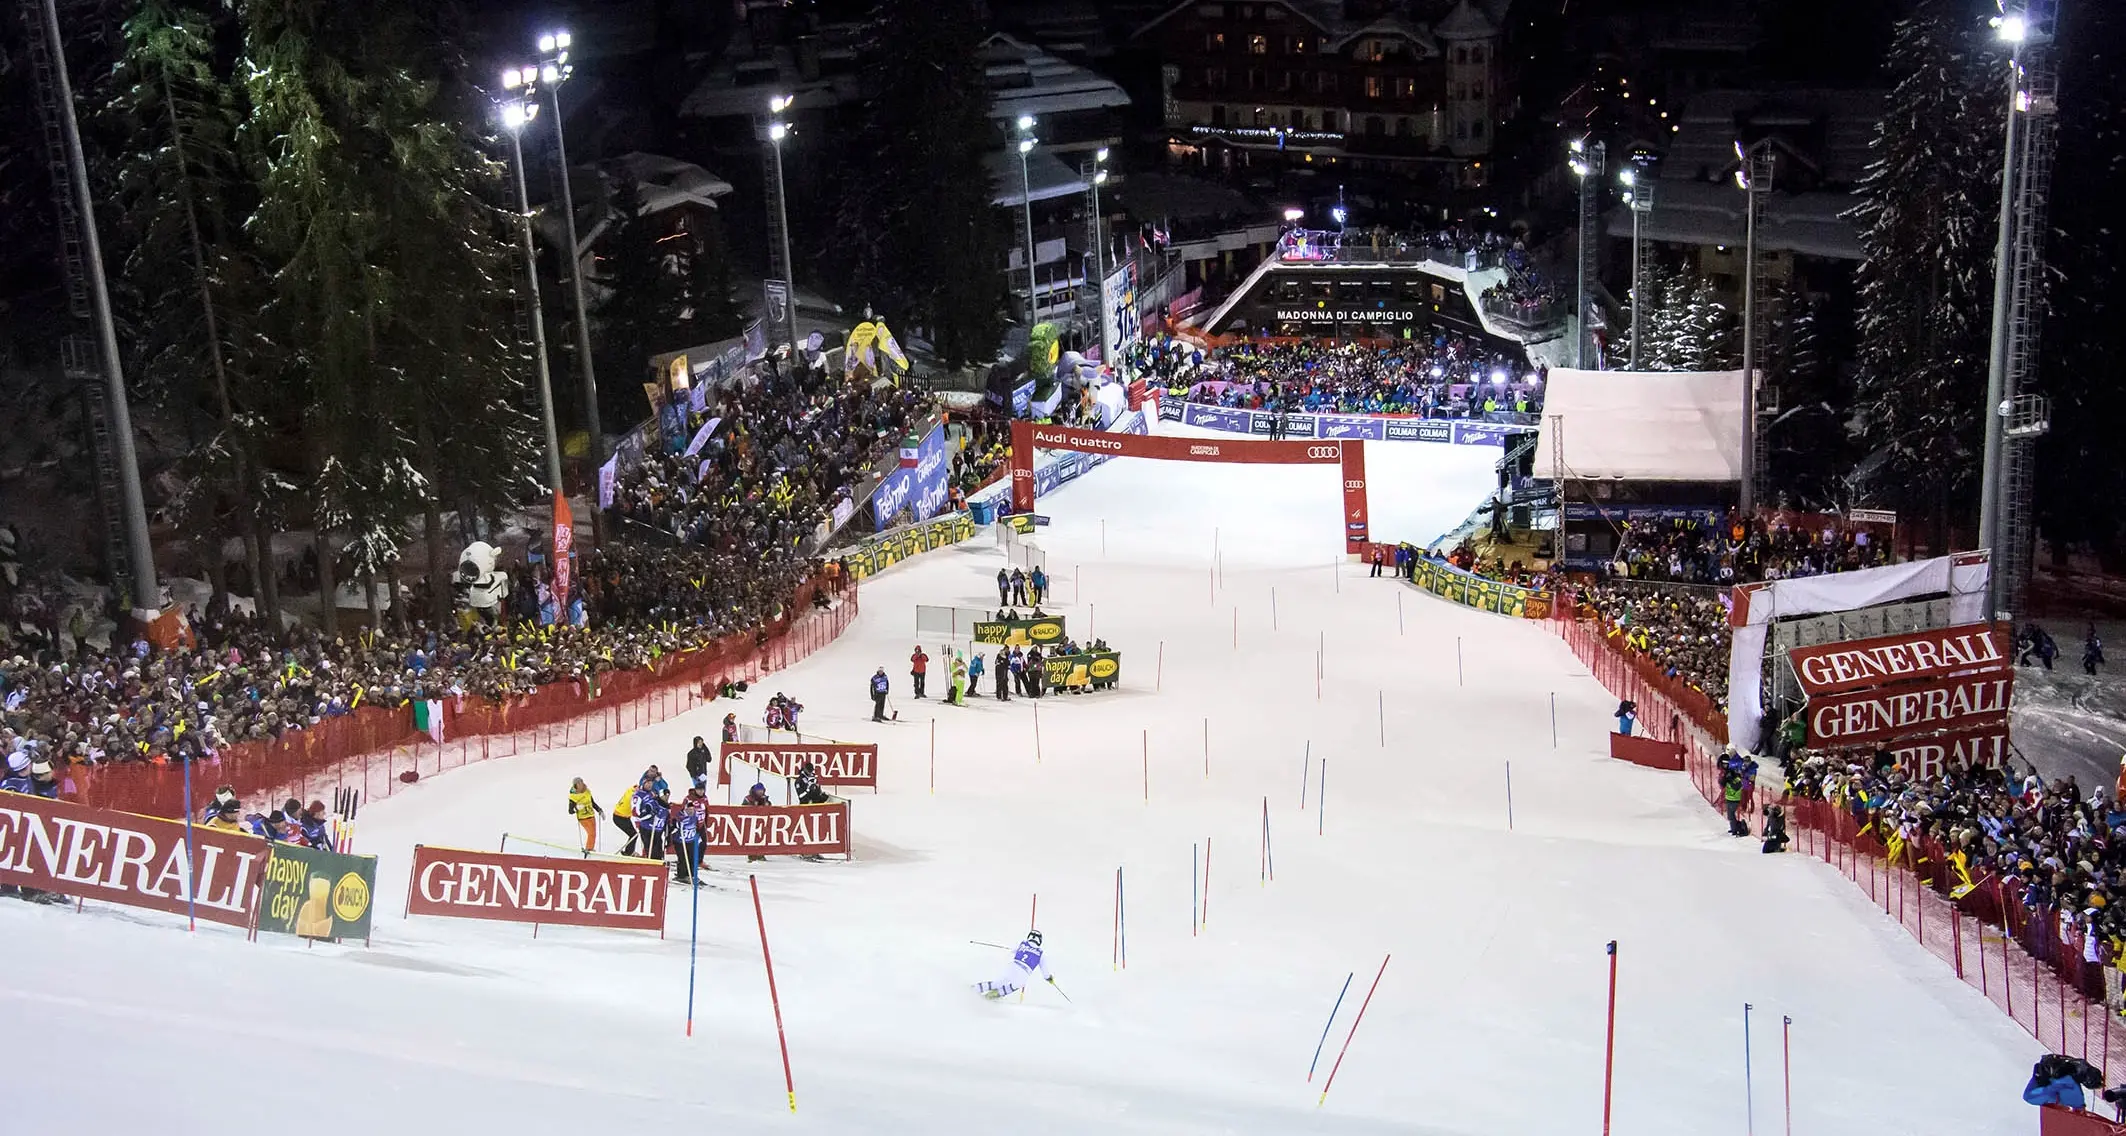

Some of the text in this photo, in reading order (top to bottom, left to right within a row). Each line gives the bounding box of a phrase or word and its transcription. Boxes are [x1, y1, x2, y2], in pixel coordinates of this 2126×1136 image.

[1277, 311, 1414, 321] MADONNA DI CAMPIGLIO
[1286, 421, 1313, 432] OLMAR
[1388, 426, 1449, 438] COLMAR COLMAR
[1035, 431, 1122, 451] Audi quattro
[977, 624, 1008, 637] happy
[1037, 628, 1058, 636] RAUCH
[984, 634, 1003, 644] day
[1801, 631, 2003, 685] GENERALI
[1045, 659, 1073, 673] happy
[1096, 663, 1114, 673] RAUCH
[1050, 672, 1066, 685] day
[1813, 679, 2008, 739] GENERALI
[1893, 735, 2005, 783] ERALI
[706, 812, 841, 847] ENERALI
[266, 848, 309, 894] happy
[419, 860, 660, 918] GENERALI
[344, 886, 364, 908] RAUCH
[271, 886, 300, 931] day
[1021, 953, 1029, 962] 2
